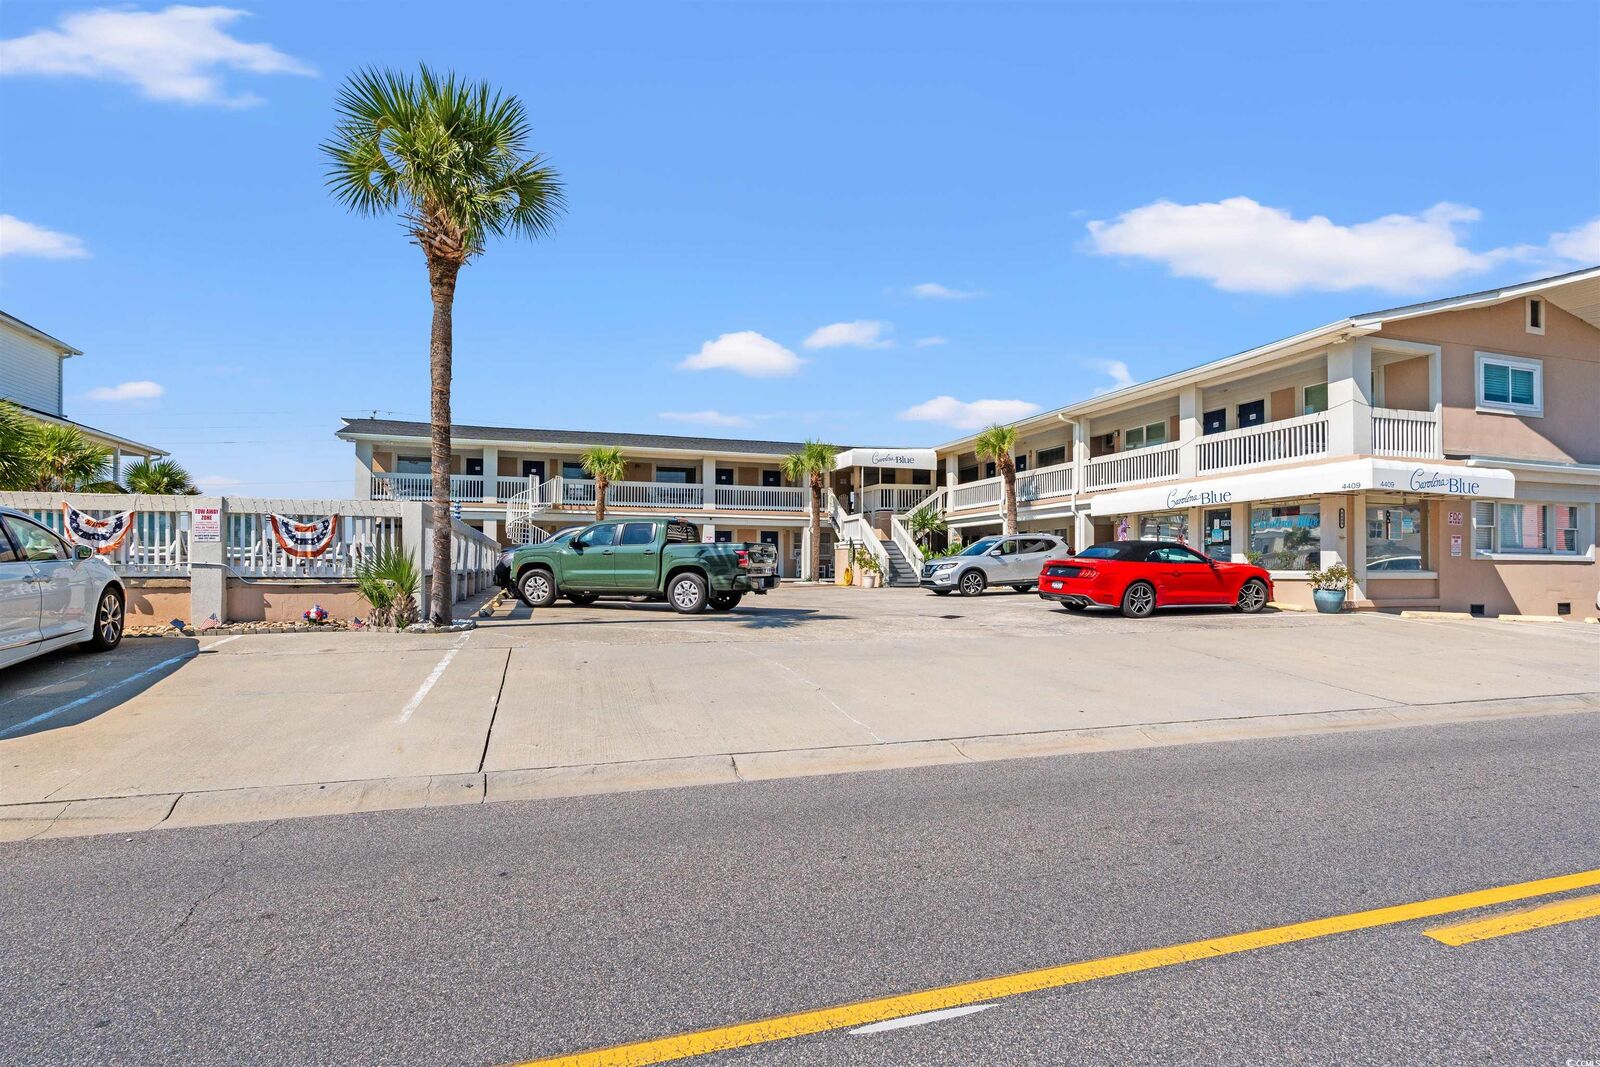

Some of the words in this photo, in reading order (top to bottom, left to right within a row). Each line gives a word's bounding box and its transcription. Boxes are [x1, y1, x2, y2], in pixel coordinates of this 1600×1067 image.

[1409, 468, 1449, 491] Carolina
[1449, 478, 1480, 495] Blue
[1167, 488, 1201, 509] Carolina
[1201, 490, 1232, 505] Blue
[1449, 512, 1462, 521] FDC
